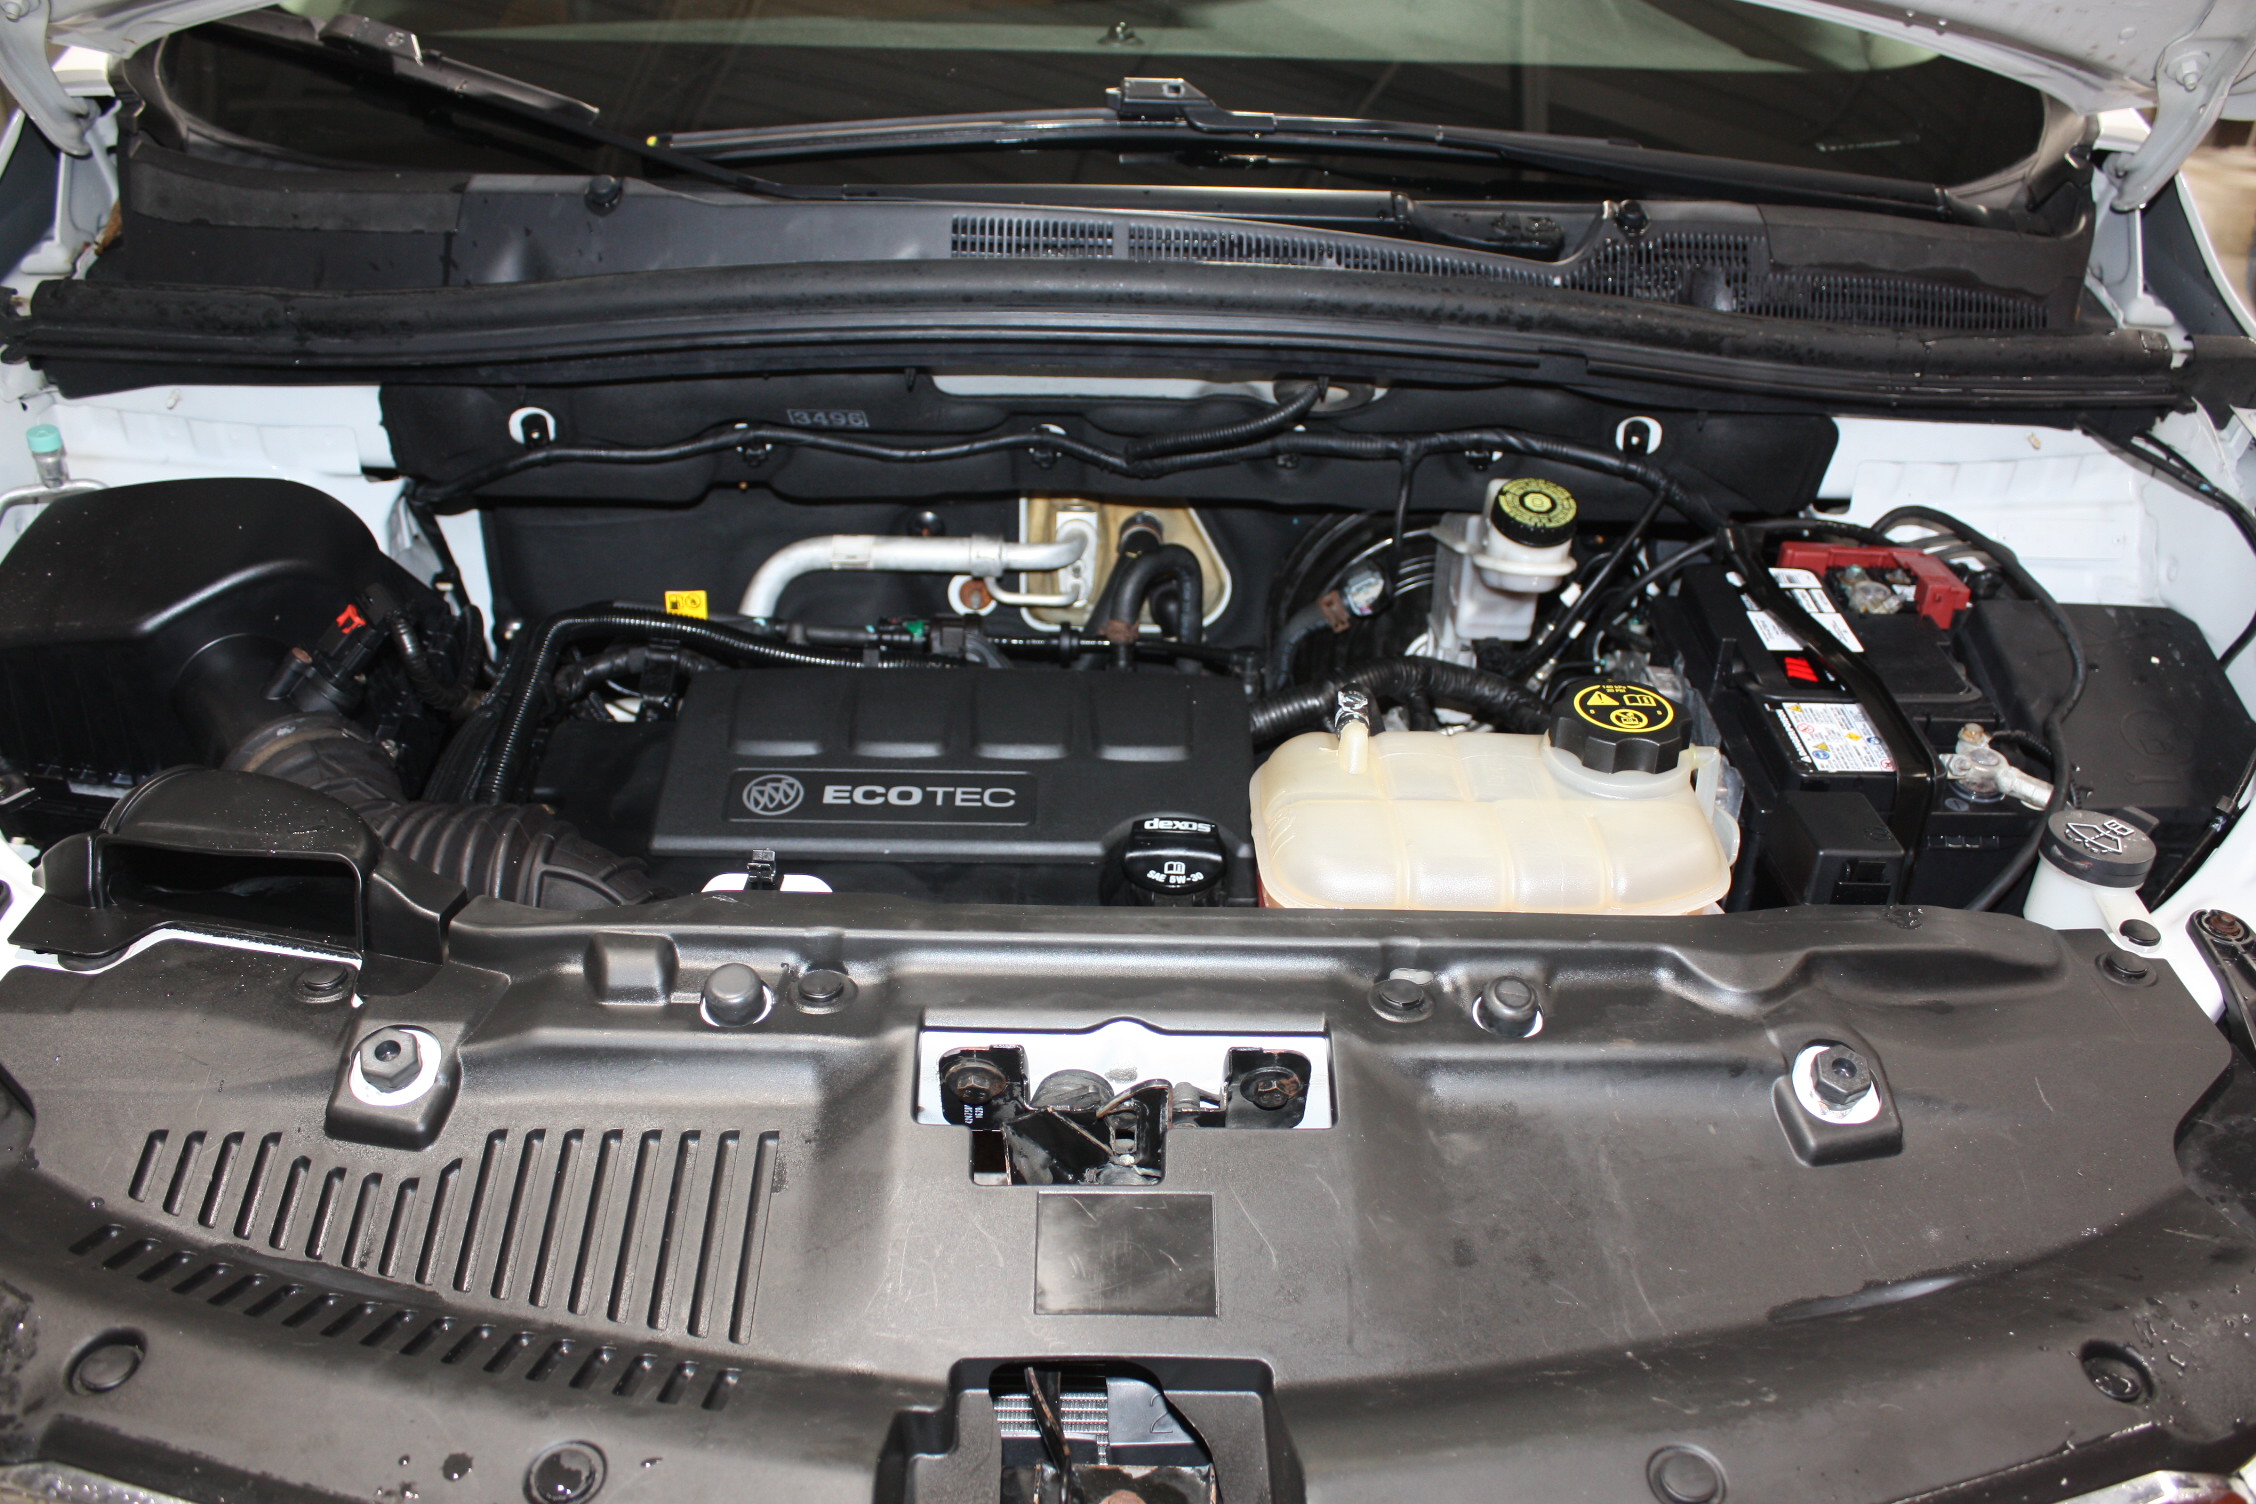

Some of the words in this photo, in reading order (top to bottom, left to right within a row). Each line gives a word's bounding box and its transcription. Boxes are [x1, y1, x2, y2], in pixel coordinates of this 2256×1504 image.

[793, 411, 864, 427] 3496
[822, 785, 1017, 808] ECOTEC
[1144, 818, 1212, 833] dexos
[1146, 870, 1167, 883] SAE
[1169, 872, 1204, 884] 5W-30
